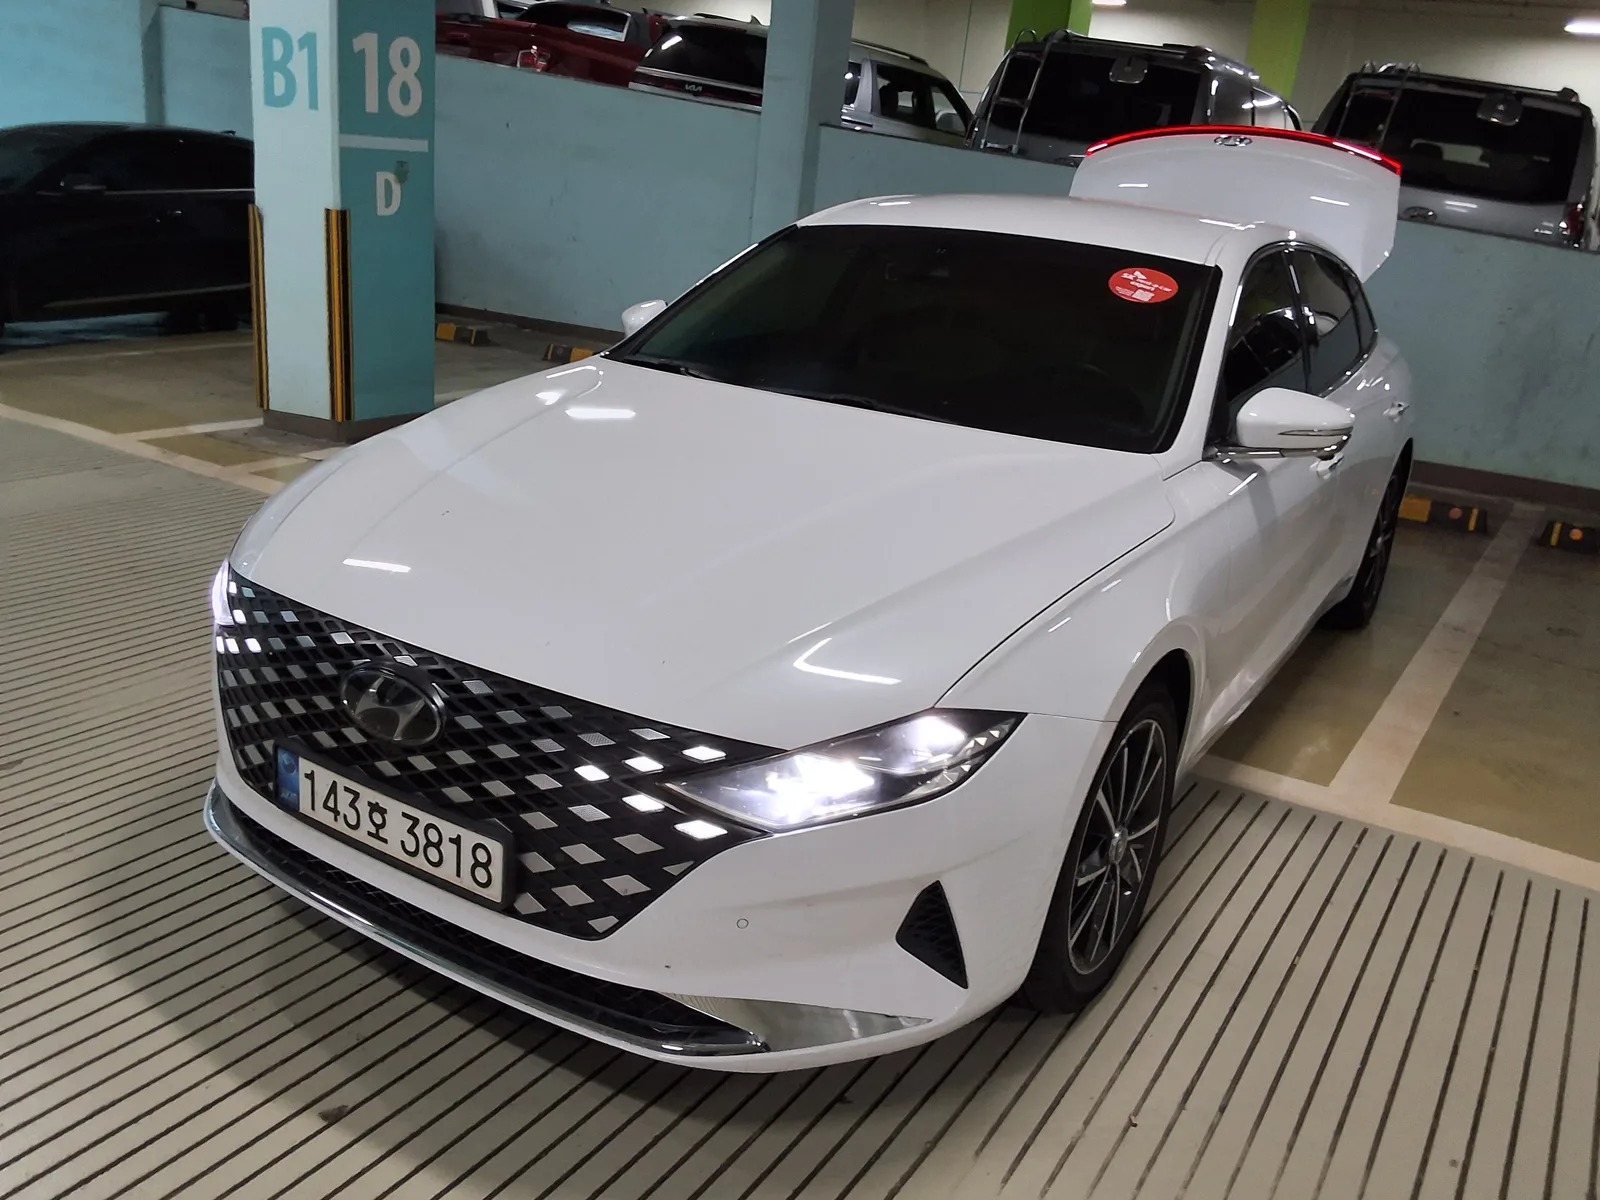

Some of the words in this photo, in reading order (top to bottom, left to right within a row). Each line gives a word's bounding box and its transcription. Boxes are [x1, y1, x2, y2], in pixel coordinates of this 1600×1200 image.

[261, 27, 319, 111] B1
[352, 32, 423, 117] 18
[376, 171, 402, 216] D
[304, 769, 389, 845] 143호
[400, 811, 493, 889] 3818
